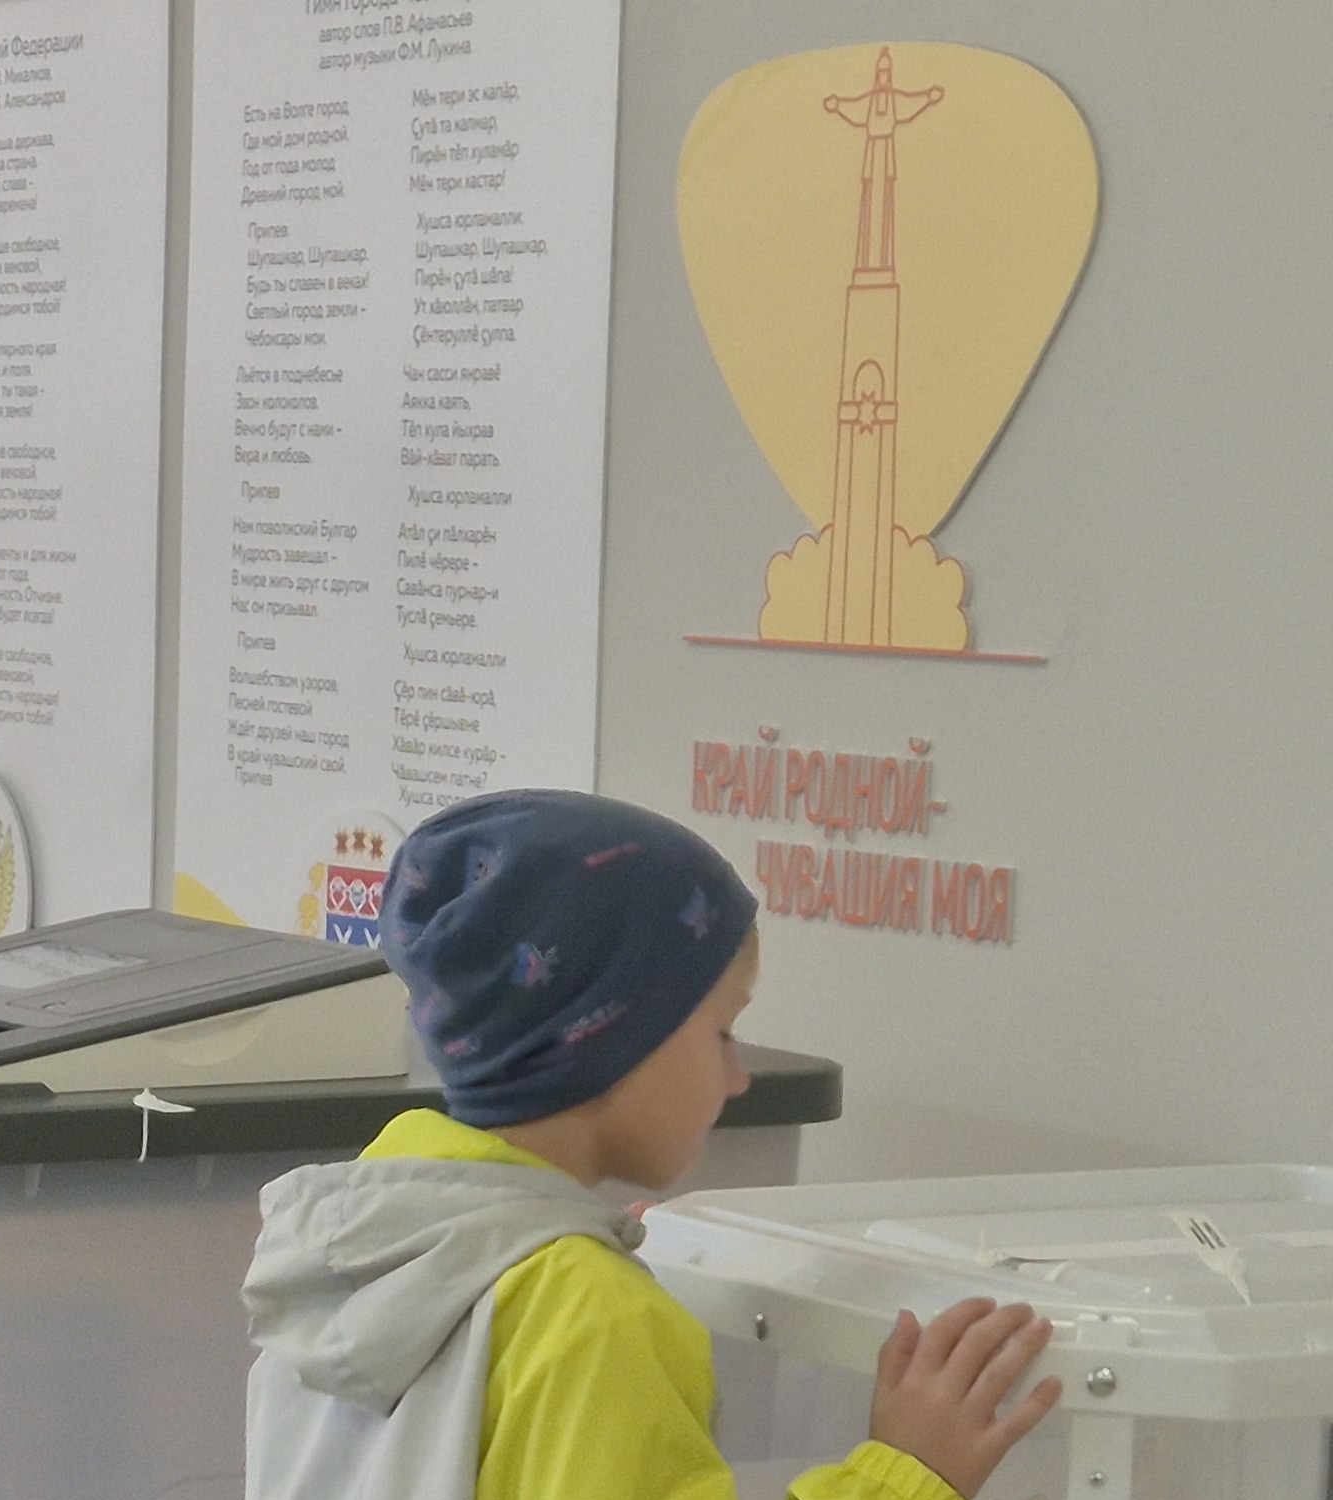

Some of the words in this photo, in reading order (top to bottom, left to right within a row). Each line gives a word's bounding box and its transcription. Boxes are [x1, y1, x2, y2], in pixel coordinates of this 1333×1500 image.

[354, 22, 380, 39] слов
[11, 34, 83, 59] Федерации
[353, 47, 396, 70] музыки
[244, 105, 266, 123] Есть
[269, 107, 281, 120] на
[283, 101, 314, 119] Волге
[243, 132, 260, 150] Где
[262, 131, 282, 147] мой
[284, 132, 305, 149] дом
[243, 159, 260, 176] Год
[262, 161, 272, 175] от
[275, 160, 299, 174] года
[241, 184, 286, 206] Древний
[289, 185, 320, 204] город
[247, 275, 271, 297] Будь
[274, 279, 286, 292] ты
[289, 278, 325, 291] славен
[328, 277, 334, 290] в
[246, 302, 289, 320] Светлый
[292, 304, 323, 322] город
[326, 303, 357, 318] земли
[246, 329, 301, 350] Чебоксары
[274, 370, 279, 382] в
[236, 392, 260, 409] Звон
[235, 419, 266, 436] Вечно
[268, 419, 296, 442] будут
[299, 424, 305, 436] с
[307, 424, 334, 437] нами
[235, 445, 260, 467] Вера
[262, 451, 268, 461] и
[233, 517, 254, 534] Нам
[321, 519, 357, 542] Булгар
[232, 543, 282, 564] Мудрость
[284, 549, 328, 564] завещал
[232, 569, 239, 586] В
[241, 574, 266, 591] мире
[268, 576, 294, 590] жить
[296, 577, 321, 594] друг
[323, 579, 328, 591] с
[330, 579, 369, 596] другом
[231, 595, 250, 613] Нас
[252, 601, 264, 613] он
[230, 666, 298, 687] Волшебством
[230, 692, 265, 711] Песней
[256, 725, 292, 744] друзей
[295, 730, 316, 743] наш
[319, 732, 349, 749] город
[228, 744, 234, 760] В
[237, 747, 261, 765] край
[263, 754, 317, 770] чувашский
[691, 725, 779, 821] КРАЙ
[756, 840, 923, 933] ЧУВАШИЯ
[931, 860, 1015, 945] МОЯ
